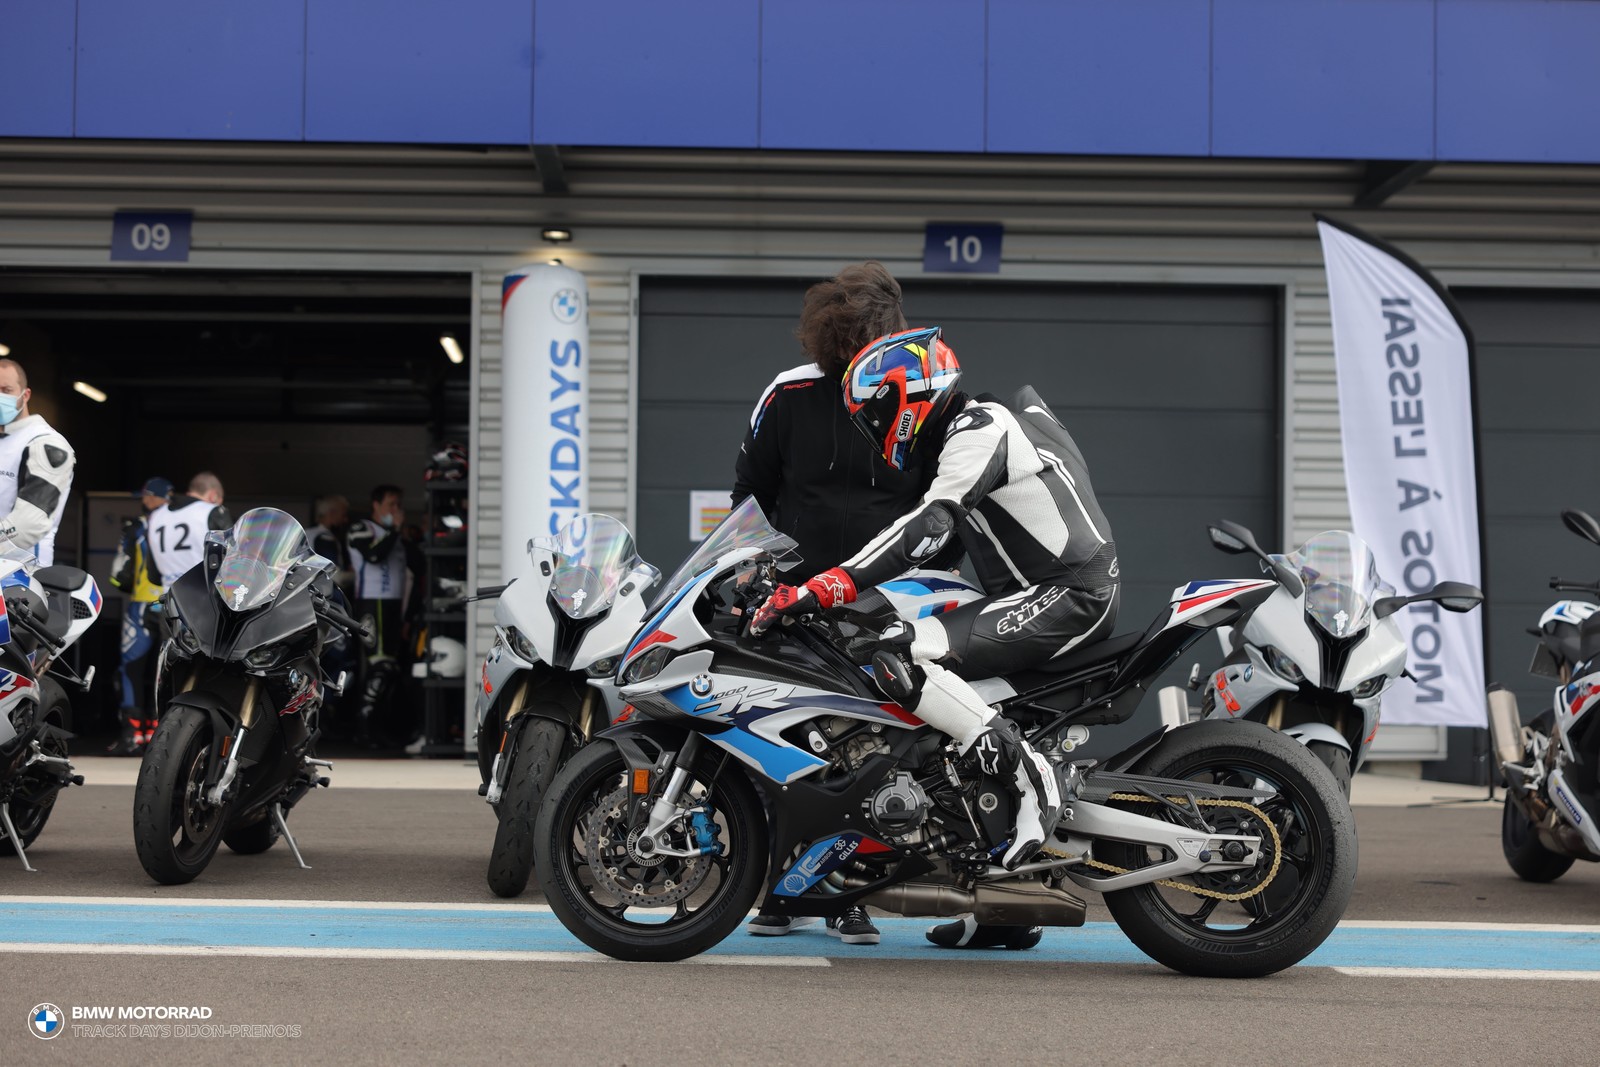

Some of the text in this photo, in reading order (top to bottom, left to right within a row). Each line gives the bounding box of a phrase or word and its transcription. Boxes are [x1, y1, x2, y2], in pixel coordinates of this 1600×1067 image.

[131, 223, 171, 251] 09
[944, 235, 982, 263] 10
[898, 413, 912, 437] SHOEI
[155, 522, 192, 553] 12
[710, 685, 748, 701] 1000
[839, 841, 858, 860] GILLES
